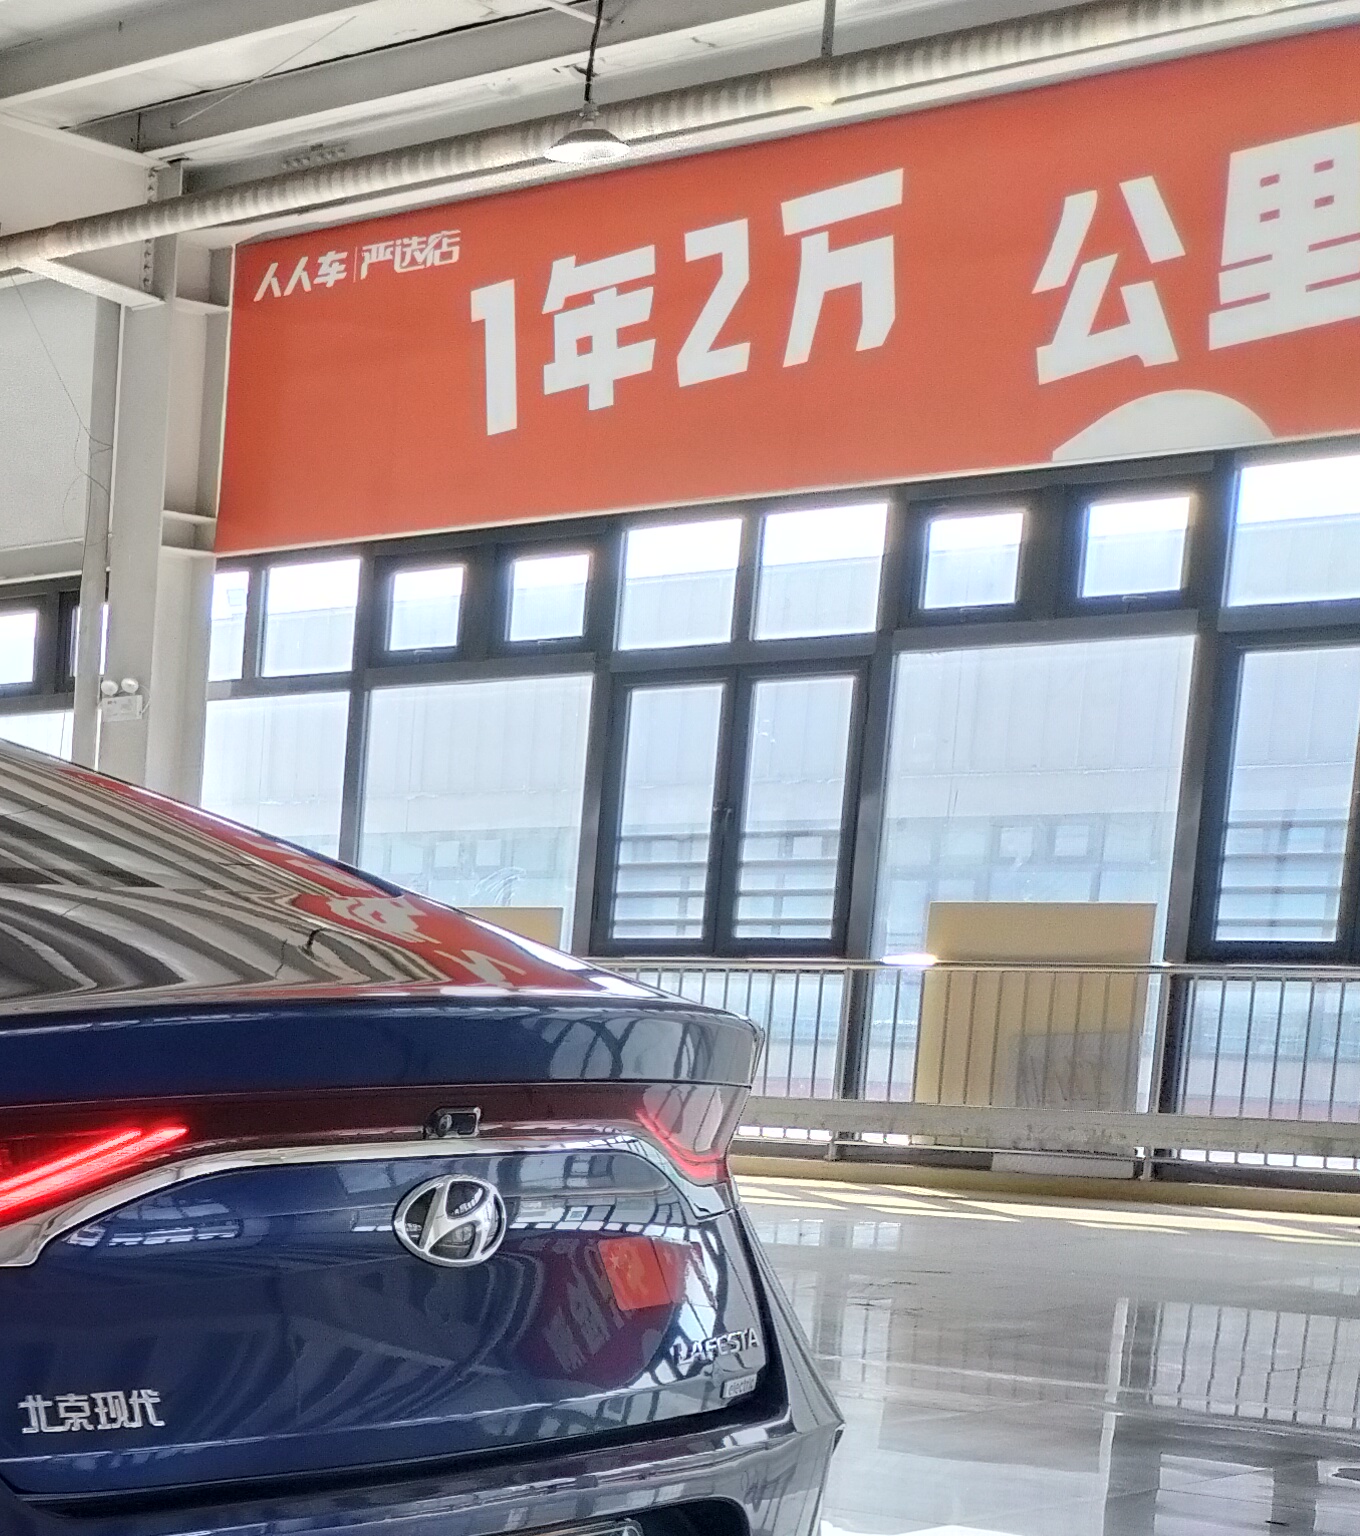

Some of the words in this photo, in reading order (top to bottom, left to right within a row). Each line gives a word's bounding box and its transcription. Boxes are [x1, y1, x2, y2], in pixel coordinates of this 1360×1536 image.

[253, 251, 348, 302] 人人车
[360, 229, 461, 280] 严选店
[471, 168, 904, 436] 1年2万
[1031, 122, 1360, 385] 公里
[675, 1327, 759, 1363] LAFESTA
[17, 1389, 166, 1434] 北京现代
